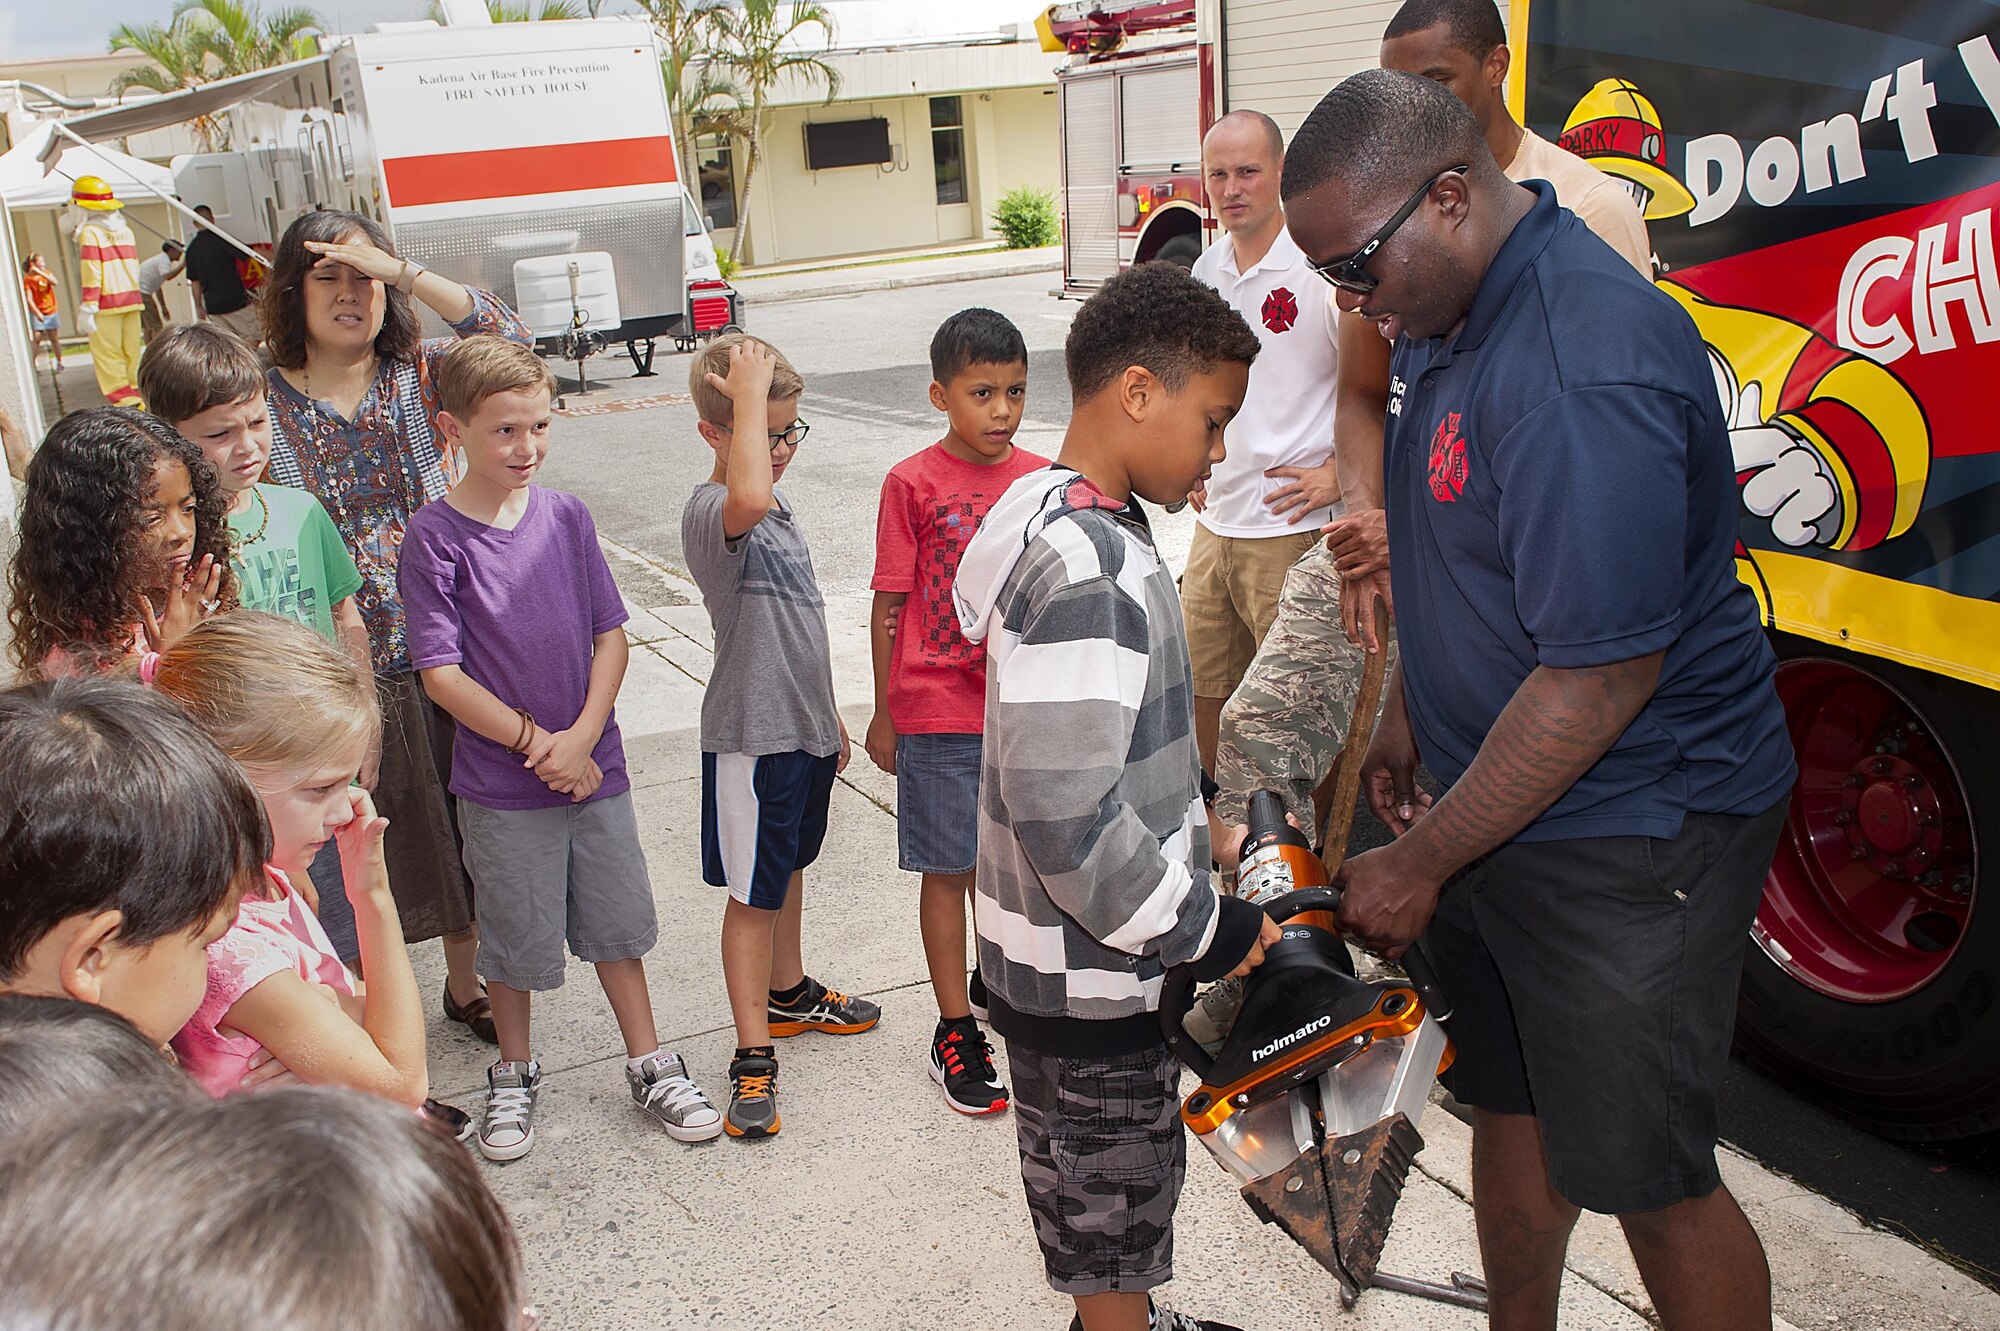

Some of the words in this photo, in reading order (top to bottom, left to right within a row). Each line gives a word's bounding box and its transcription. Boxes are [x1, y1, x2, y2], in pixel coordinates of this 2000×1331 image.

[419, 74, 464, 86] Kadena
[470, 70, 487, 82] Air
[491, 70, 518, 81] Base
[521, 67, 545, 78] Fire
[549, 62, 610, 76] Prevention
[445, 88, 476, 101] FIRE
[484, 84, 537, 98] SAFETY
[544, 81, 590, 94] HOUSE
[1685, 58, 1938, 228] Don't
[1251, 1015, 1331, 1063] holmatro
